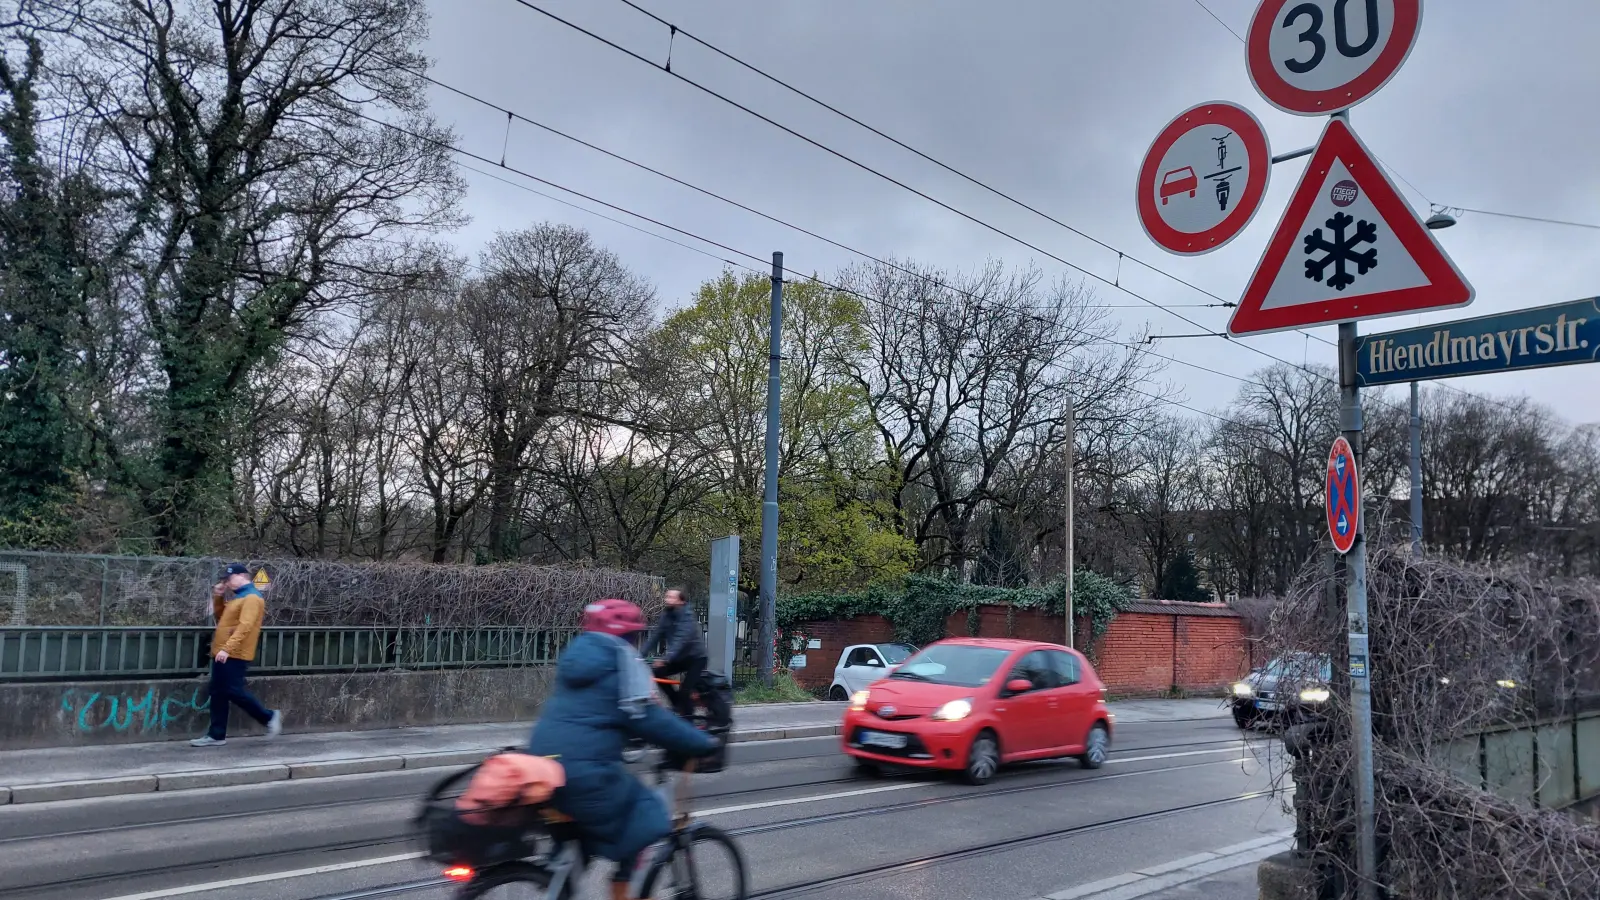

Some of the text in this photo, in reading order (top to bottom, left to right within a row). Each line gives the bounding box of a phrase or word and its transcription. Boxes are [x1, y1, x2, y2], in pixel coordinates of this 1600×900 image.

[1282, 0, 1379, 73] 30
[1333, 187, 1356, 196] MEGA
[1369, 313, 1588, 375] Hiendlmayrstr.
